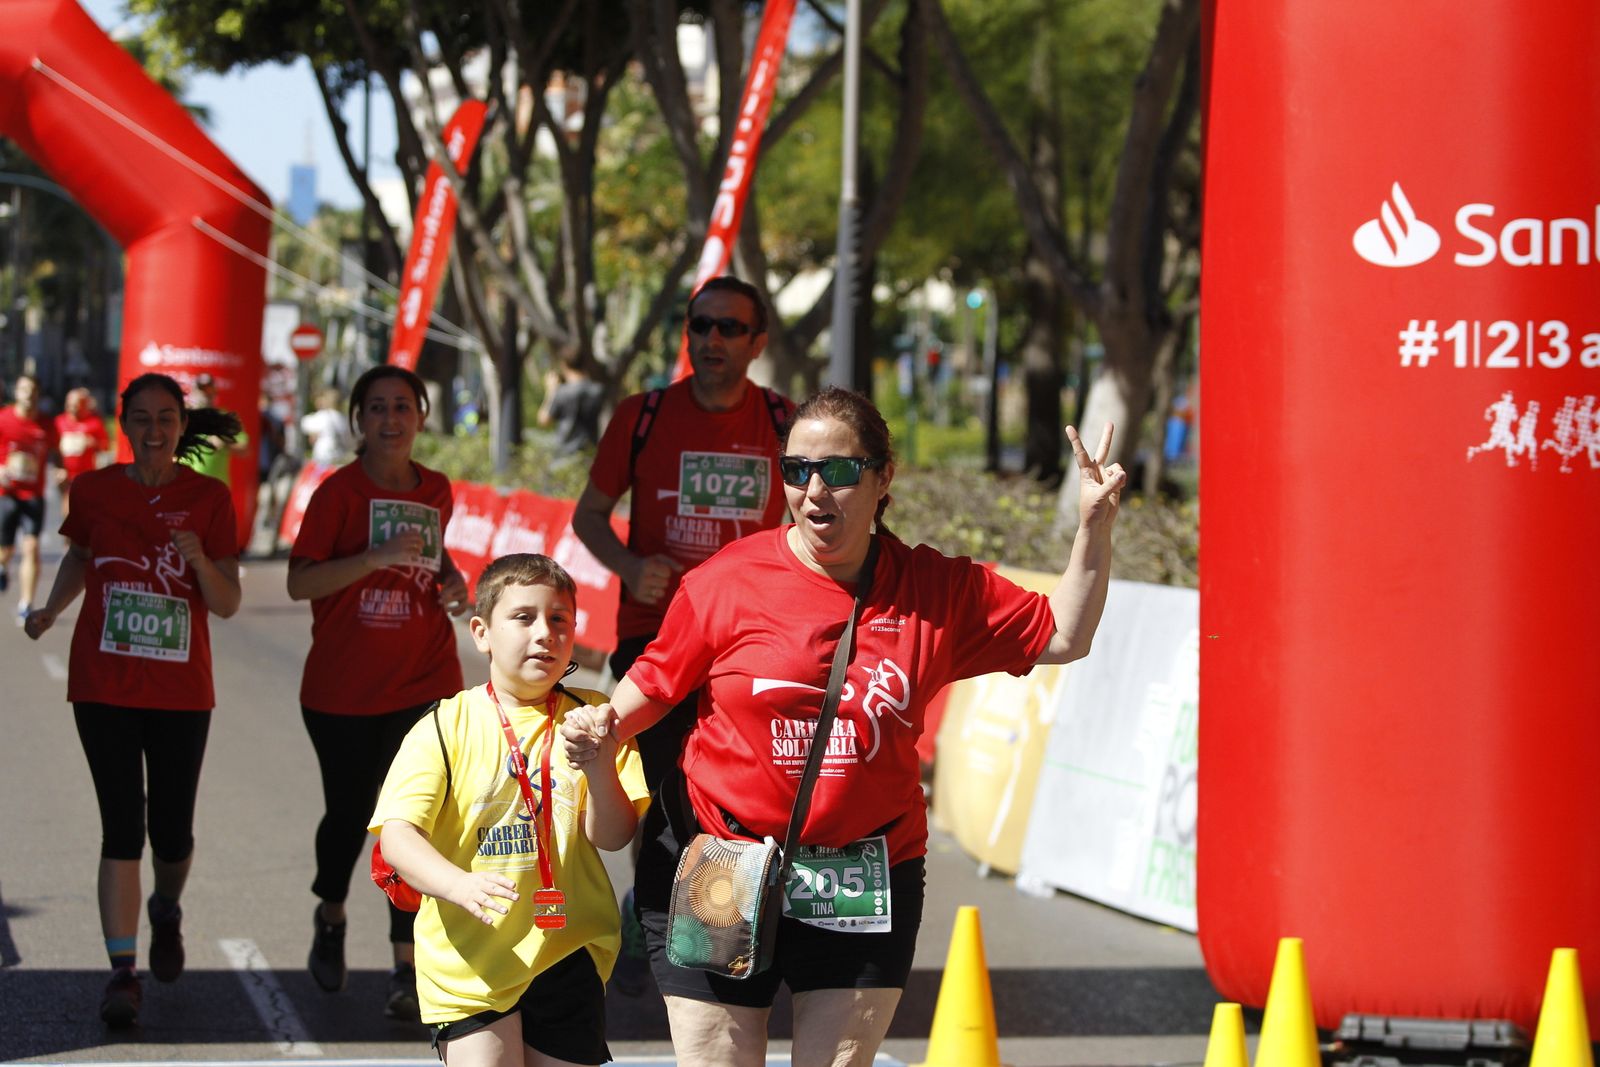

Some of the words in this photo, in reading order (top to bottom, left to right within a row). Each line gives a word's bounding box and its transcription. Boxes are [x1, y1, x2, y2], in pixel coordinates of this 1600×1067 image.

[690, 472, 755, 497] 1072
[113, 609, 174, 637] 1001
[771, 717, 857, 738] CARRRA
[772, 738, 858, 757] SOLIRIA
[790, 866, 865, 899] 205
[810, 901, 835, 915] TINA
